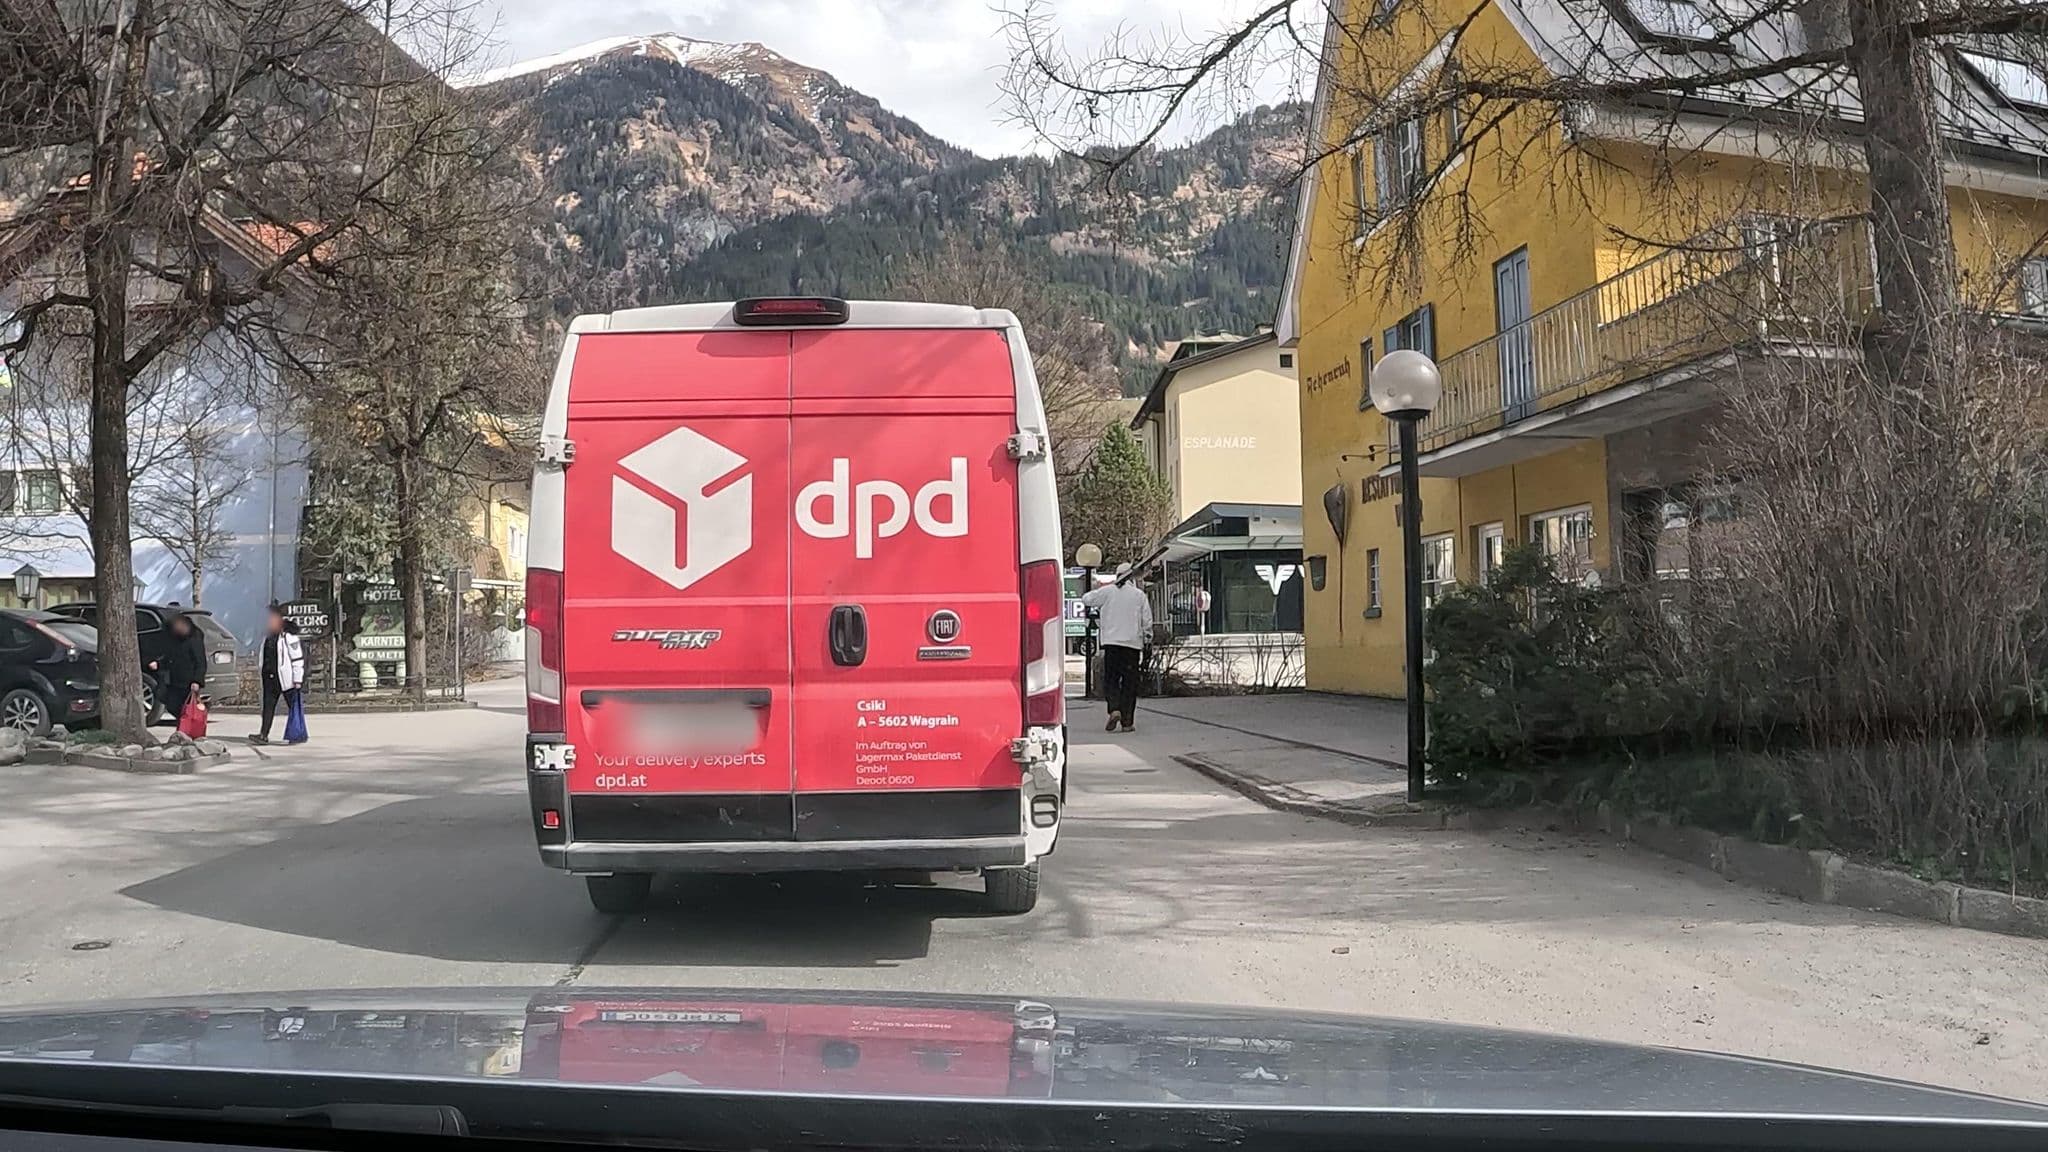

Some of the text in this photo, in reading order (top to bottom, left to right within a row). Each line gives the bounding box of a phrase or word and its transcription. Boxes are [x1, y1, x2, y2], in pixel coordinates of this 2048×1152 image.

[1184, 436, 1257, 449] ESPLANADE
[795, 457, 968, 558] dpd
[363, 590, 405, 601] HOTEL
[288, 604, 322, 615] HOTEL
[935, 619, 954, 634] FIAT
[611, 629, 722, 642] DUCATO
[857, 700, 886, 711] Csiki
[857, 716, 867, 727] A
[878, 715, 908, 727] 5602
[909, 714, 959, 728] Wagrain
[856, 741, 927, 751] Im Auftrag von
[594, 752, 766, 769] Your delivery experts
[856, 752, 962, 763] Lagermax Paketdienst
[856, 765, 888, 774] GmbH
[595, 774, 648, 789] dpd.at
[888, 776, 915, 785] 0620
